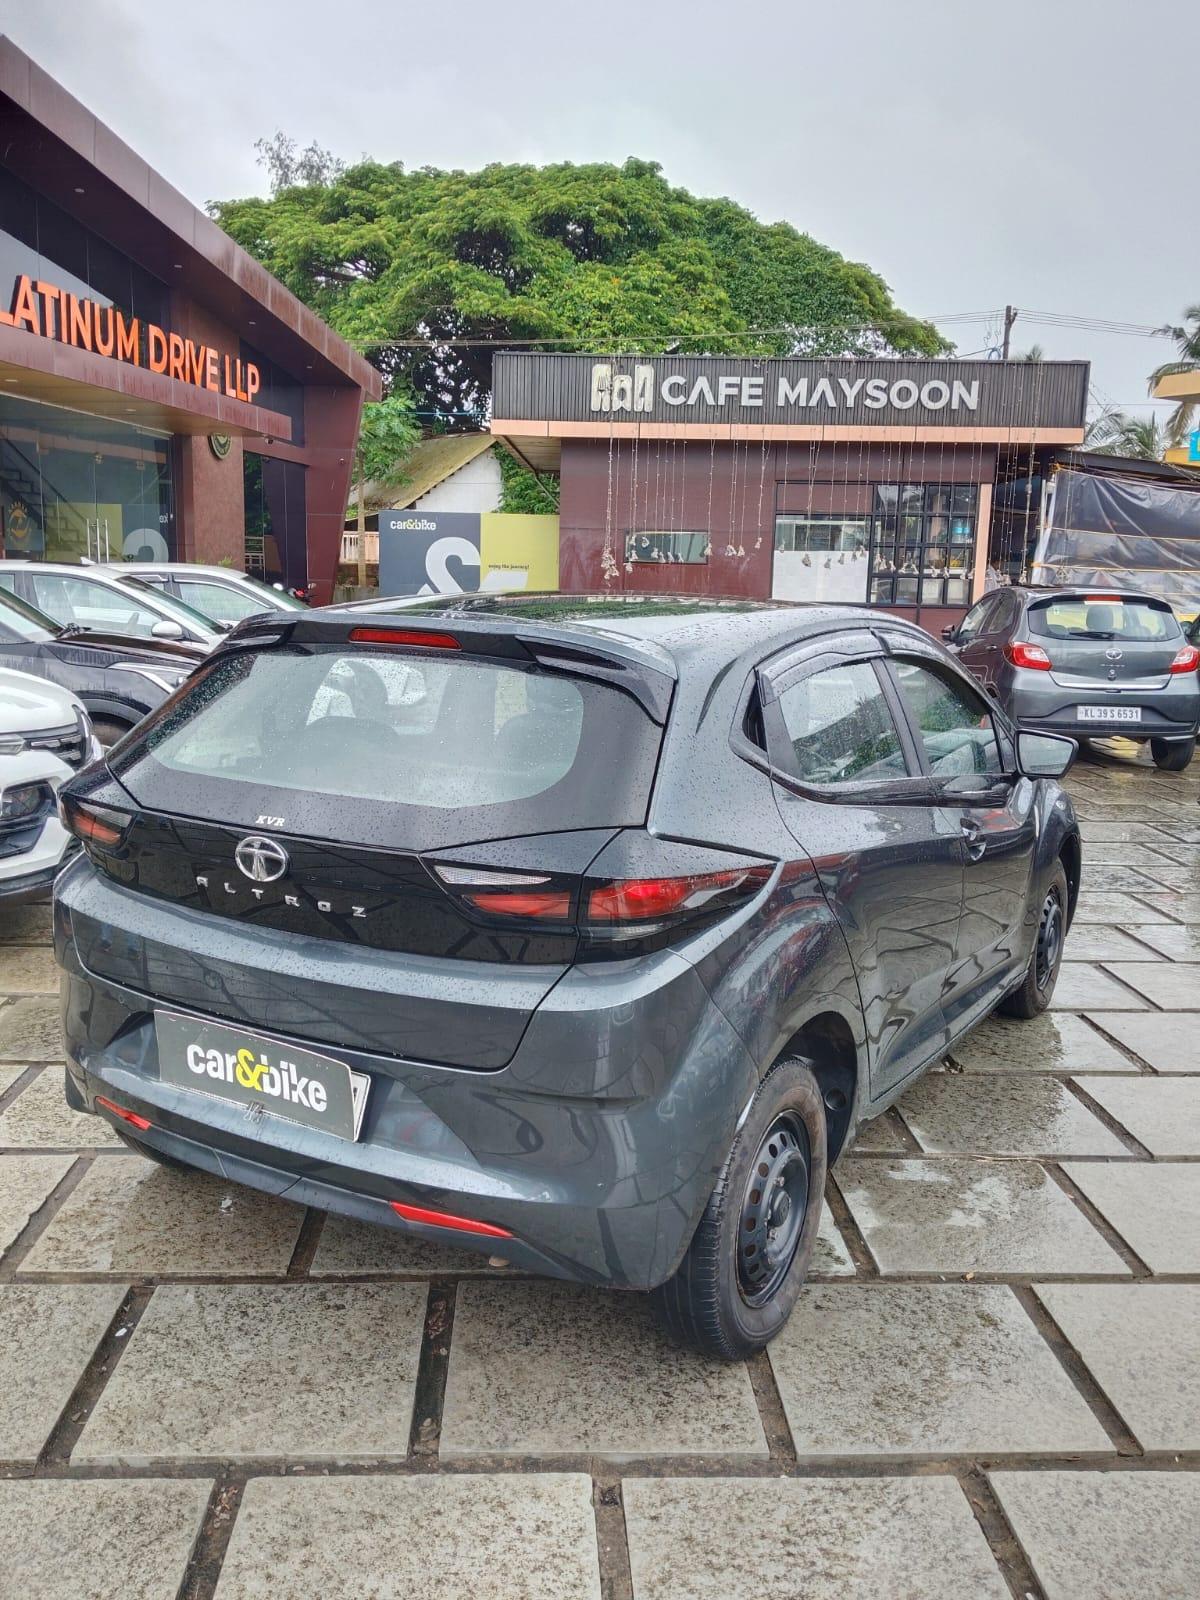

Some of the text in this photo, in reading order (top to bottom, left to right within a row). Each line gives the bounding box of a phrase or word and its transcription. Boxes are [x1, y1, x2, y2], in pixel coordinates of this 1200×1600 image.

[149, 324, 219, 392] DRIVE
[225, 354, 259, 402] LLP
[661, 375, 980, 410] CAFE MAYSOON
[390, 519, 437, 531] car&bike
[1084, 708, 1138, 719] KL 39 S 6531
[256, 815, 285, 827] KVR
[196, 876, 367, 918] ALTROZ
[186, 1043, 328, 1113] car&bike
